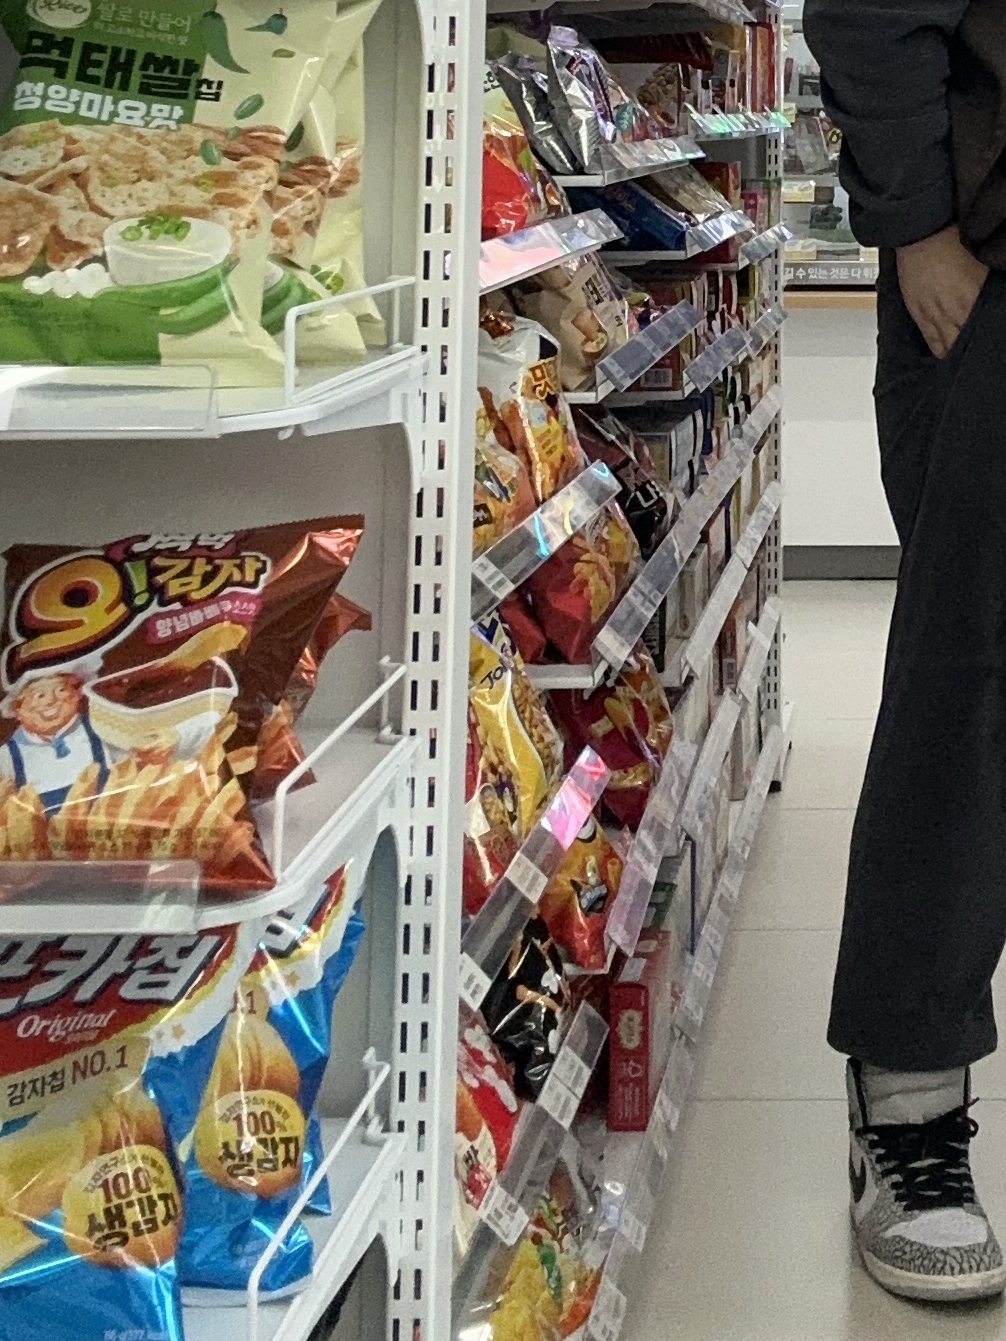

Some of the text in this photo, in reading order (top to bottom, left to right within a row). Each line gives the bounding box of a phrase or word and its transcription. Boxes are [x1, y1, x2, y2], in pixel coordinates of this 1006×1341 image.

[14, 80, 185, 131] 청양마요맛
[17, 1009, 117, 1042] Original
[7, 1044, 128, 1108] 감자칩 NO.1
[84, 1191, 178, 1252] 생감자
